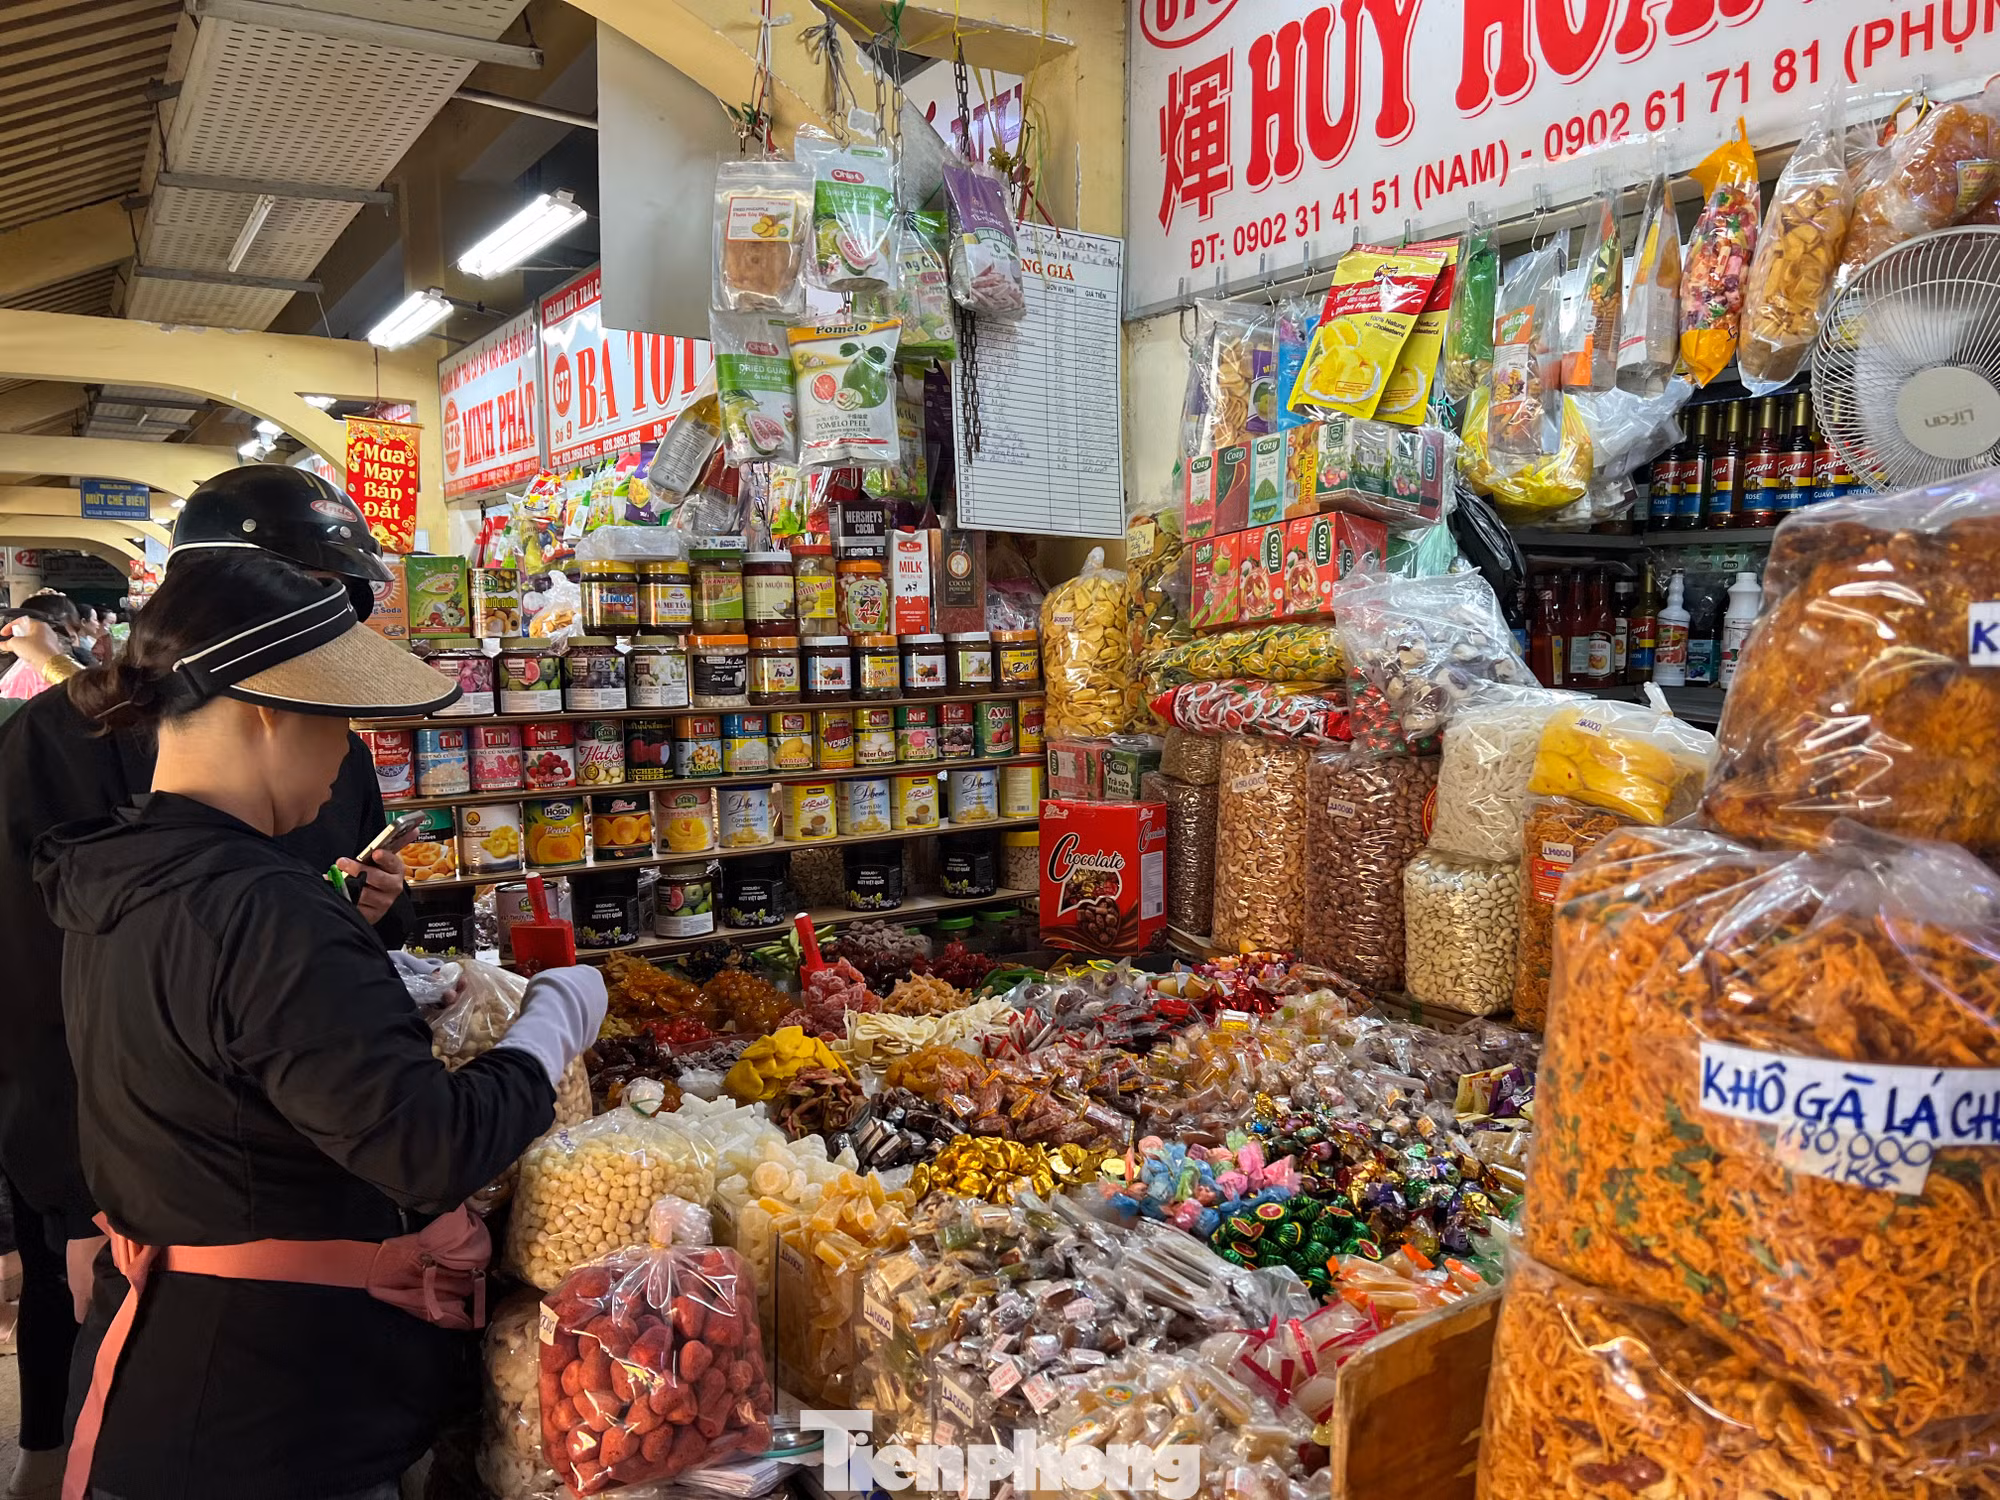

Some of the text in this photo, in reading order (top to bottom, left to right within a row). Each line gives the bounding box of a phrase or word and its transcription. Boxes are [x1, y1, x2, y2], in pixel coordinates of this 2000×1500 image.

[1246, 0, 1424, 193] HUY
[1190, 233, 1225, 270] ĐT:
[1233, 213, 1287, 257] 0902
[1295, 205, 1320, 248] 31
[1332, 188, 1359, 224] 41
[1372, 174, 1401, 214] 51
[1414, 139, 1509, 211] (NAM)
[1544, 101, 1630, 163] 0902
[1644, 82, 1685, 132] 61
[1706, 61, 1750, 113] 71
[1772, 40, 1820, 93] 81
[1047, 263, 1075, 281] GIÁ
[815, 323, 867, 335] Pomelo
[462, 366, 537, 468] MINH PHÁT
[816, 420, 848, 430] POMELO
[444, 422, 460, 451] 678
[364, 443, 406, 465] Mua
[1257, 440, 1278, 452] Cozy
[1226, 449, 1245, 462] Cozy
[1191, 459, 1210, 471] Cozy
[1745, 459, 1773, 476] Torani
[363, 462, 404, 487] May
[364, 481, 403, 501] Bán
[363, 500, 401, 520] Đắt
[845, 510, 883, 524] HERSHEY'S
[855, 522, 876, 534] COCOA
[1269, 533, 1280, 568] Cozy
[1317, 524, 1328, 560] Cozy
[899, 561, 923, 573] MILK
[381, 606, 402, 614] Soda
[1112, 761, 1128, 774] Cozy
[1108, 777, 1117, 785] Trà
[1108, 783, 1129, 796] Matcha
[546, 807, 571, 817] HOSEN
[1048, 832, 1126, 883] Chocolate
[1702, 1056, 1787, 1116] KHÔ
[1882, 1070, 1945, 1140] LÁ
